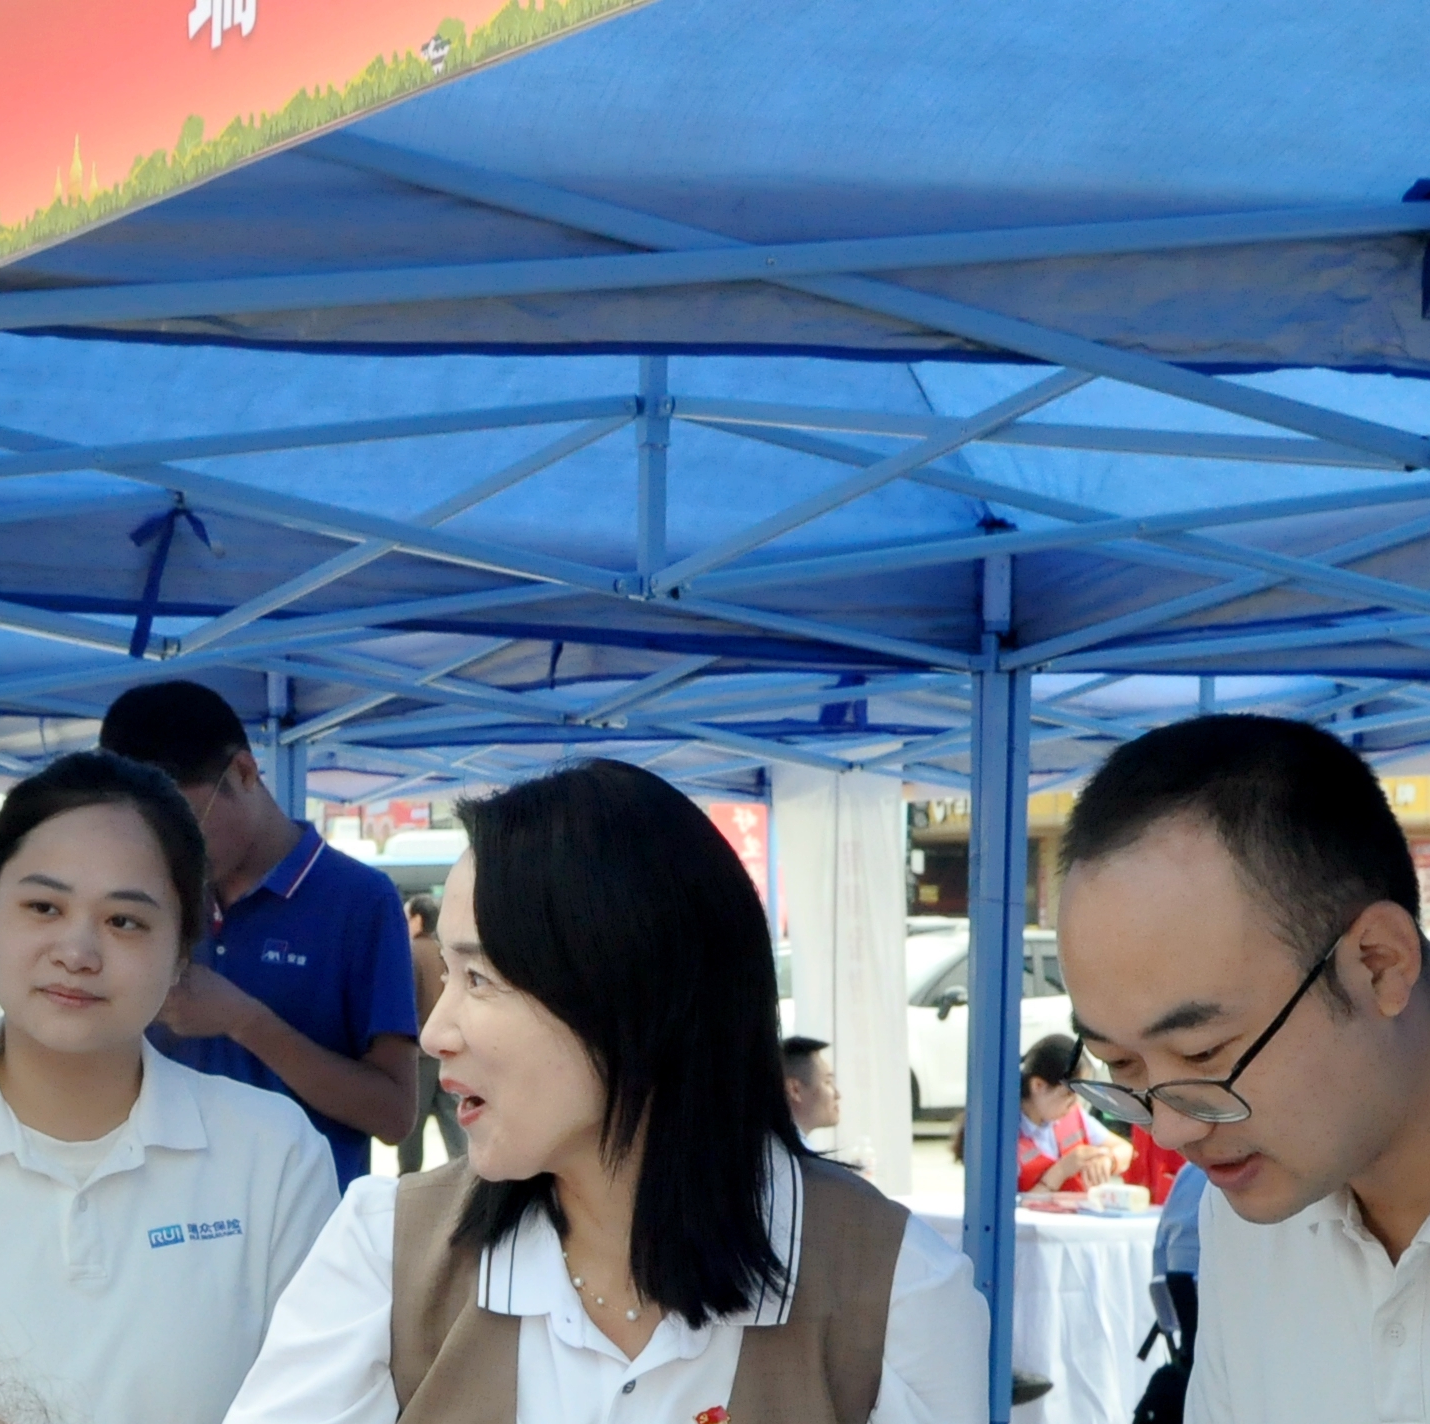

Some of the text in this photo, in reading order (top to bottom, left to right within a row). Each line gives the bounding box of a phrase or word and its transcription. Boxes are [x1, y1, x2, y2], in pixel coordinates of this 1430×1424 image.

[150, 1218, 240, 1246] RUI 瑞众保险
